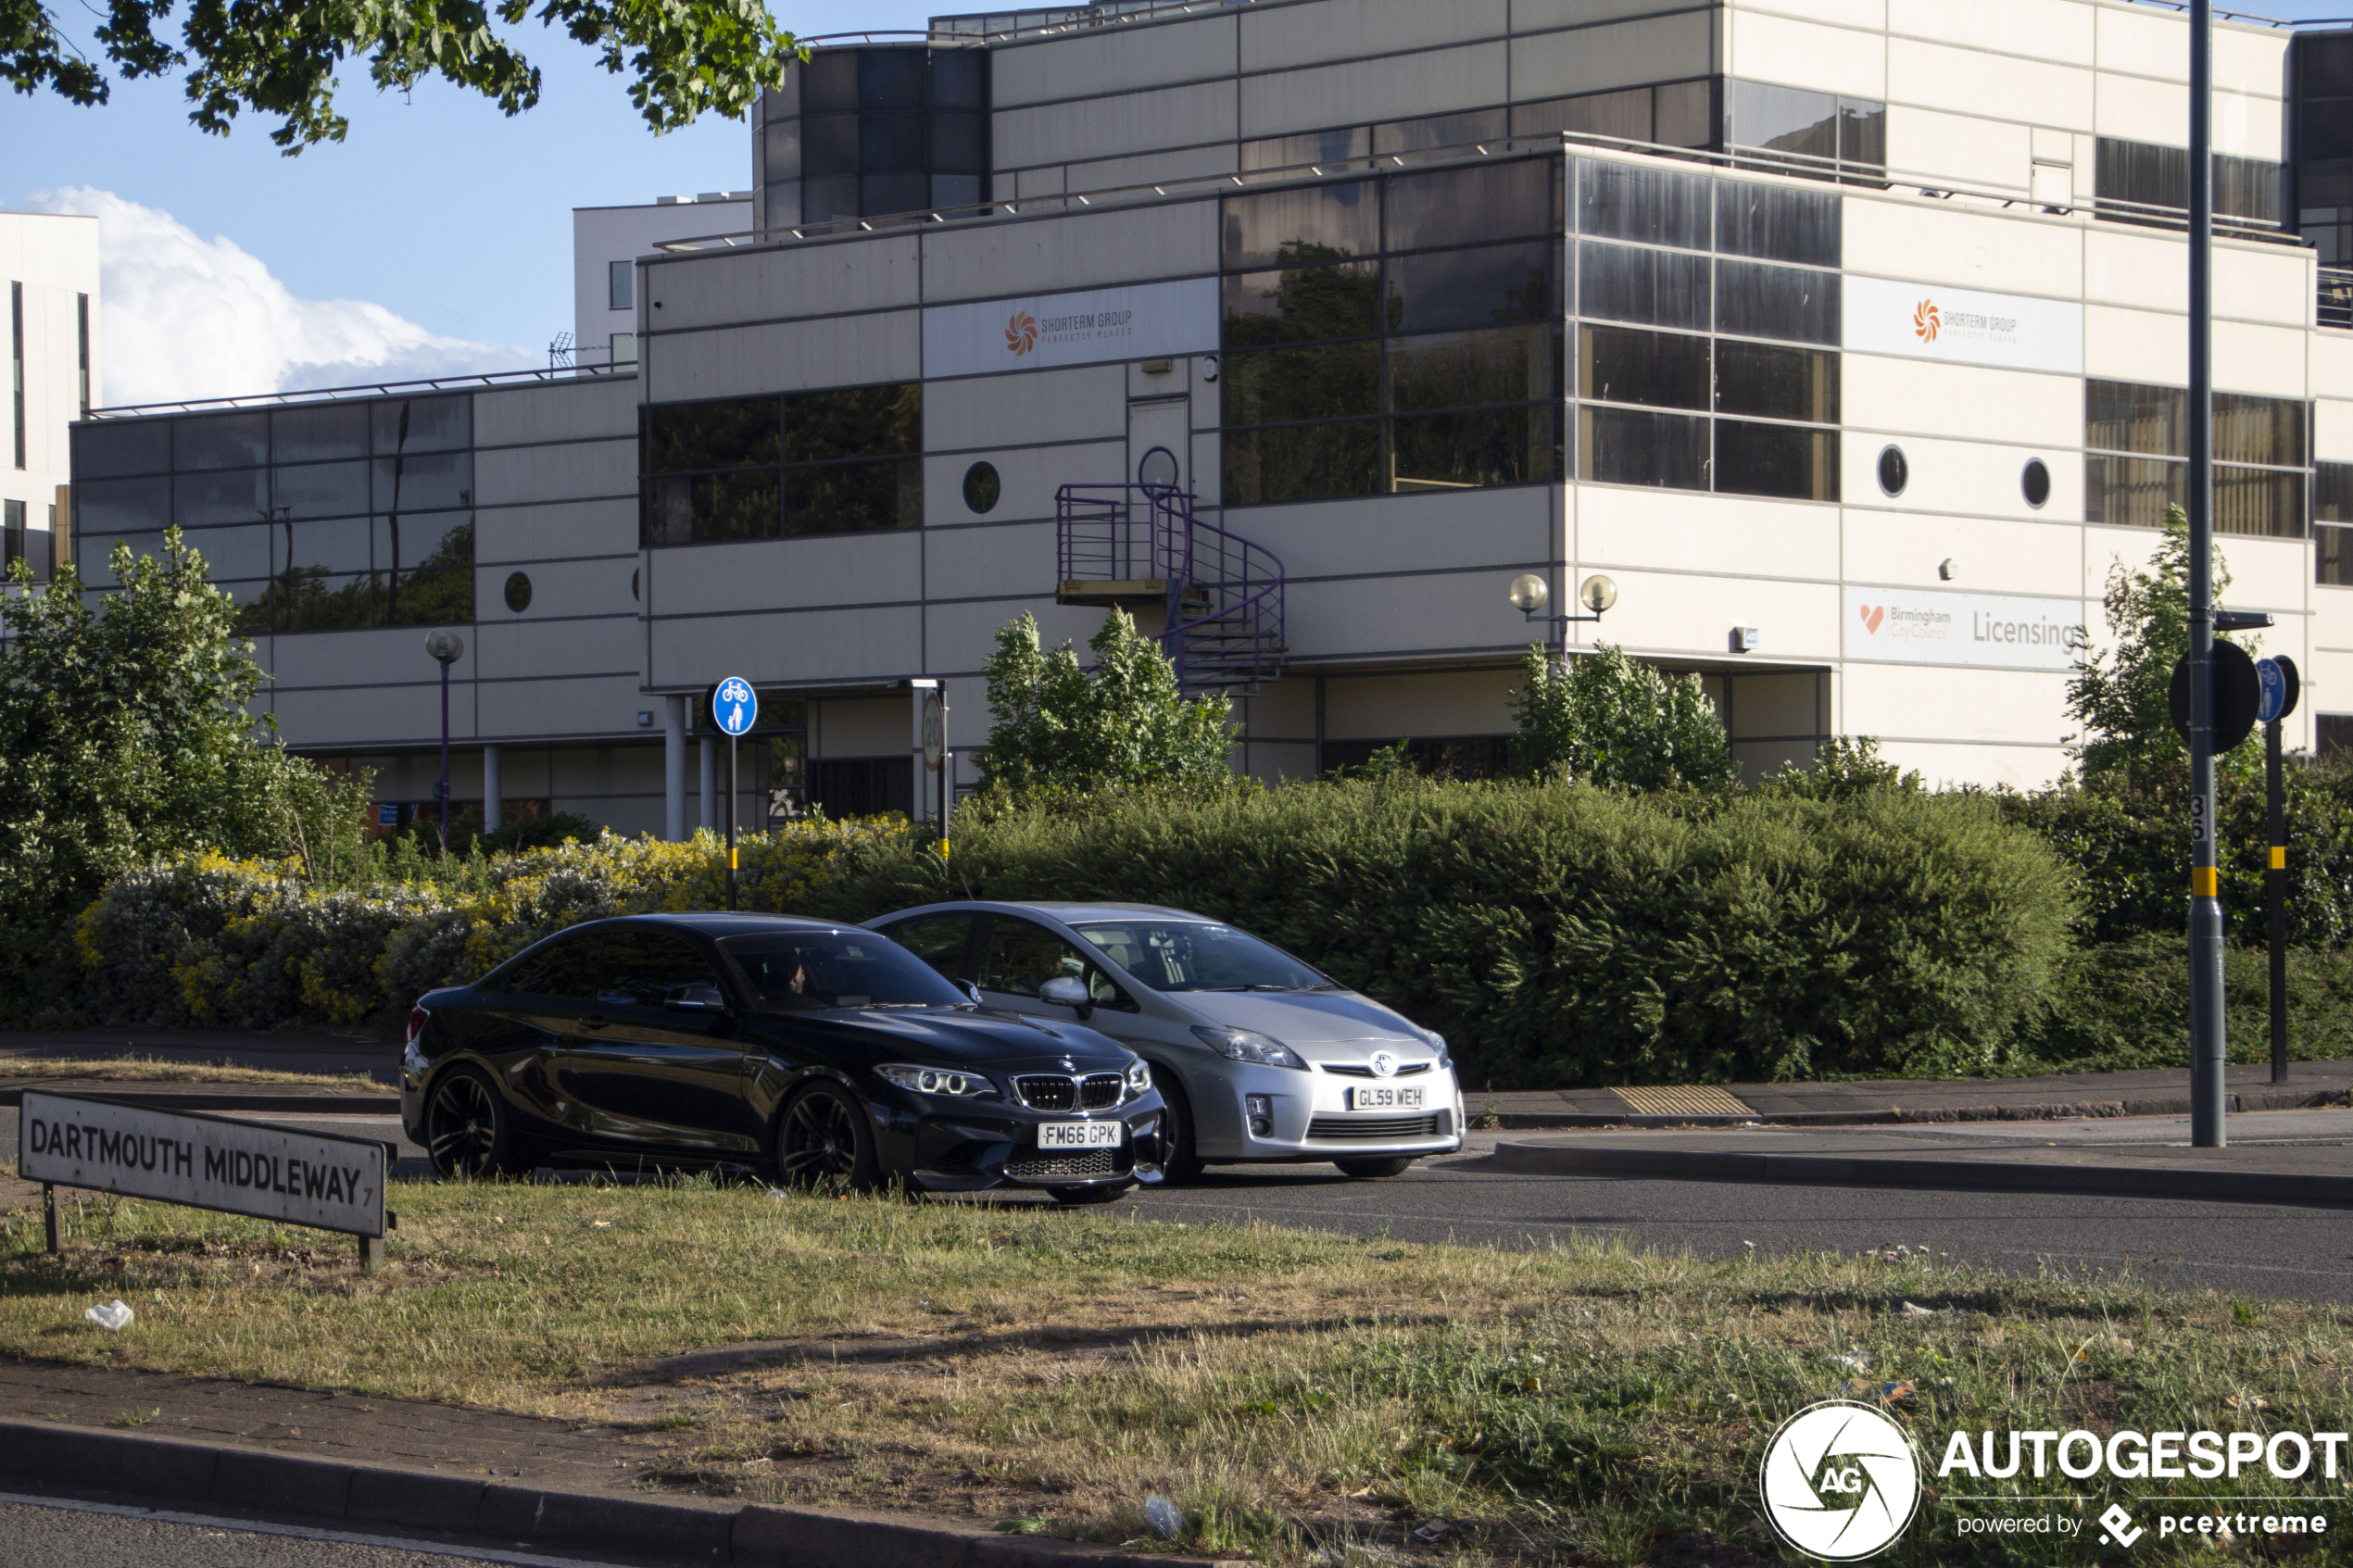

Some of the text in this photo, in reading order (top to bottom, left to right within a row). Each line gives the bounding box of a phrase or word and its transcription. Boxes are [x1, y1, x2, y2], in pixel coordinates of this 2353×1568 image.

[1041, 310, 1132, 333] SHORTERM GROUP
[1944, 311, 2017, 332] SHORTERM GROUP
[1041, 327, 1132, 344] PERFECTLY PLACED
[1891, 607, 1951, 626] Birmingham
[1891, 622, 1948, 641] City Council
[1973, 611, 2074, 656] Licensing
[925, 715, 940, 748] 20
[1359, 1088, 1422, 1106] GL59 WEH
[1045, 1125, 1115, 1145] FM66 GPK
[31, 1118, 373, 1207] DARTMOUTH MIDDLEWAY 7
